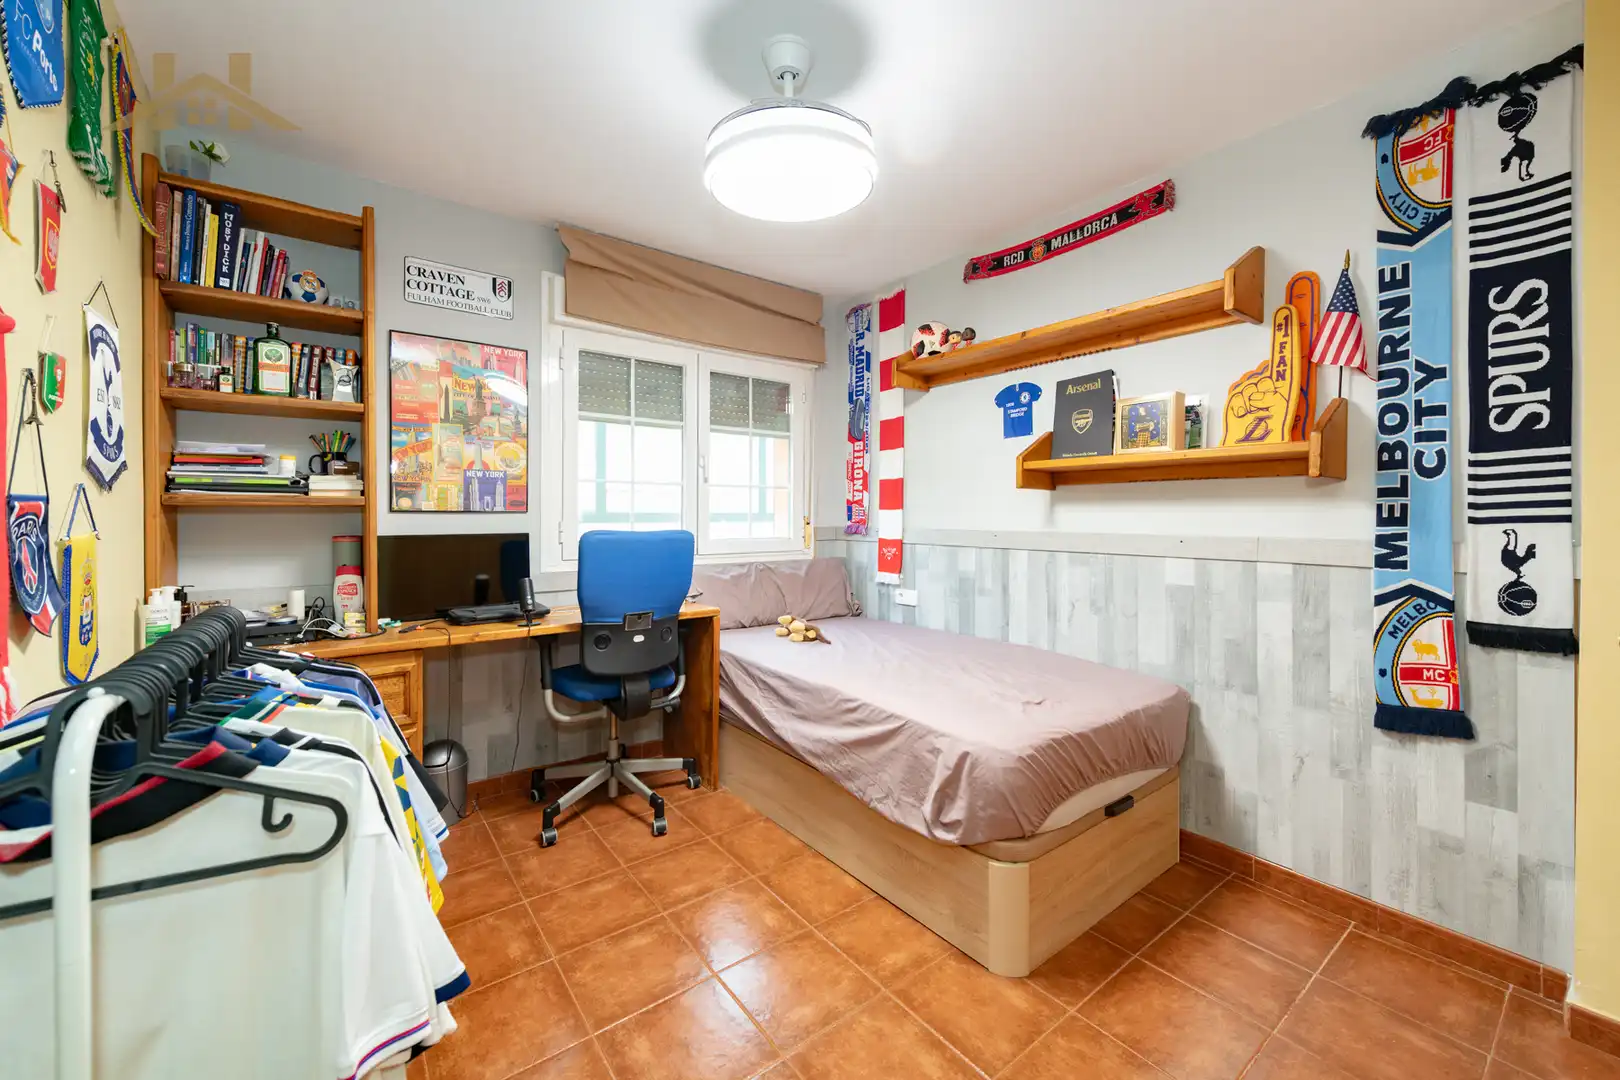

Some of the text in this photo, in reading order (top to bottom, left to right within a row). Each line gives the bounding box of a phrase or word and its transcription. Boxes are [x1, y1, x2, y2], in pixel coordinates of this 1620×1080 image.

[32, 29, 59, 92] Porto
[1424, 130, 1442, 151] FC
[1388, 192, 1420, 221] CITY
[224, 212, 234, 242] MOBY
[1003, 212, 1118, 267] RCD MALLORCA
[222, 243, 231, 273] DICK
[406, 264, 466, 286] CRAVEN
[406, 279, 491, 305] COTTAGE SW6
[407, 292, 512, 318] FULHAM FOOTBALL CLUB
[1276, 315, 1290, 339] #1
[484, 345, 525, 359] NEW YORK
[855, 331, 865, 398] R. MADRID
[1275, 341, 1288, 382] FAN
[1488, 278, 1551, 433] SPURS
[454, 377, 476, 392] NEW
[1065, 378, 1102, 395] Arsenal
[1373, 260, 1412, 571] MELBOURNE
[1412, 355, 1449, 481] CITY
[466, 470, 483, 478] NEW
[853, 441, 864, 501] GIRONA
[12, 520, 38, 541] PARIS
[1422, 668, 1446, 681] MC
